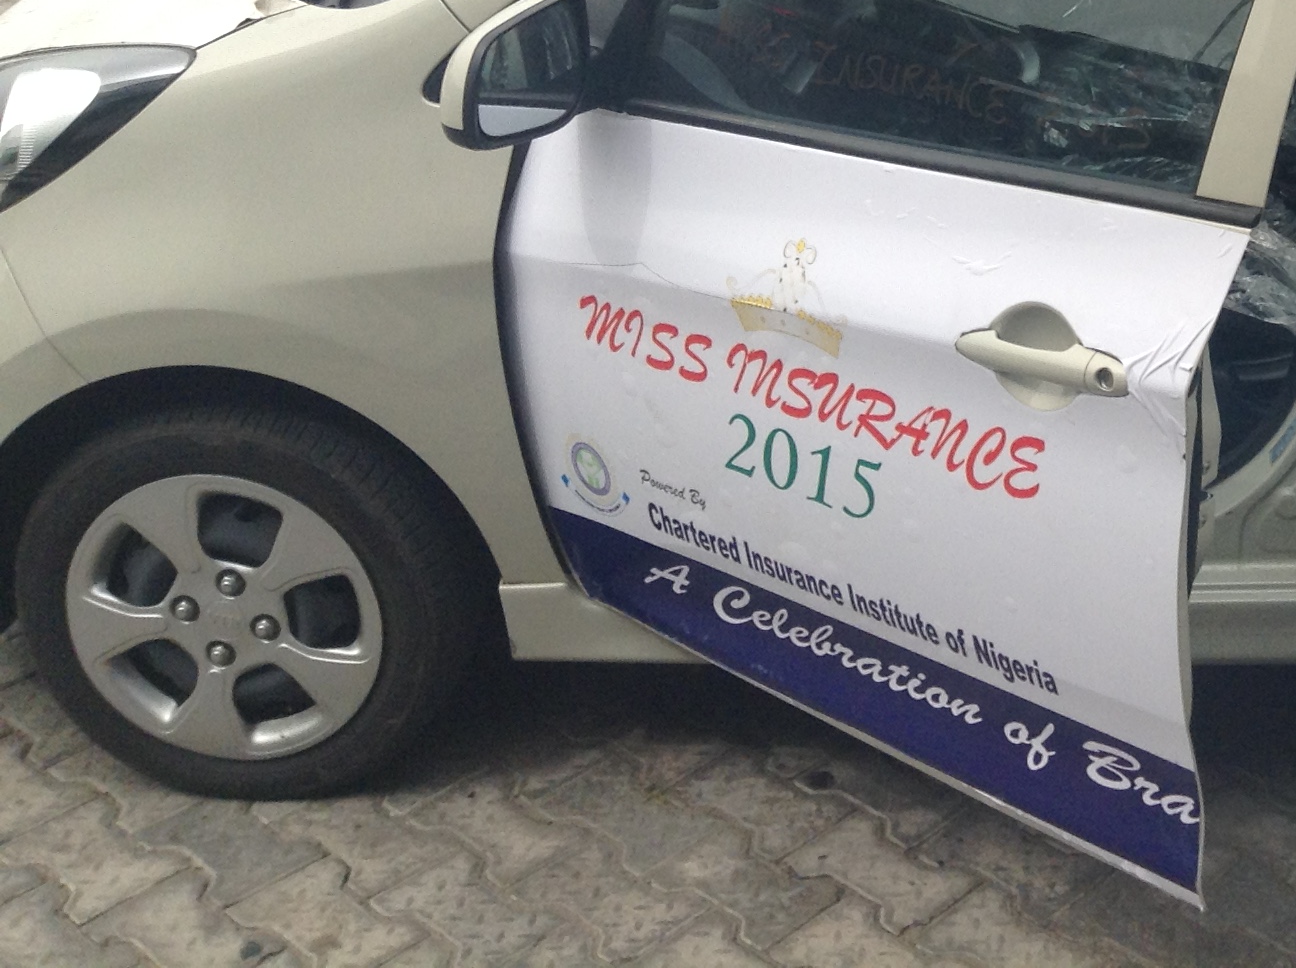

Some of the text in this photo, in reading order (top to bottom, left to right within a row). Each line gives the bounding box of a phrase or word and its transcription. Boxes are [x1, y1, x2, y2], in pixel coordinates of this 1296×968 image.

[579, 295, 1046, 500] MISS INSURANCE
[639, 469, 706, 510] Powered By
[724, 413, 884, 519] 2015
[644, 564, 690, 594] A
[713, 585, 983, 724] Celebration
[1003, 722, 1055, 771] of
[648, 502, 1060, 696] Chartered Insurance Institute of Nigeria
